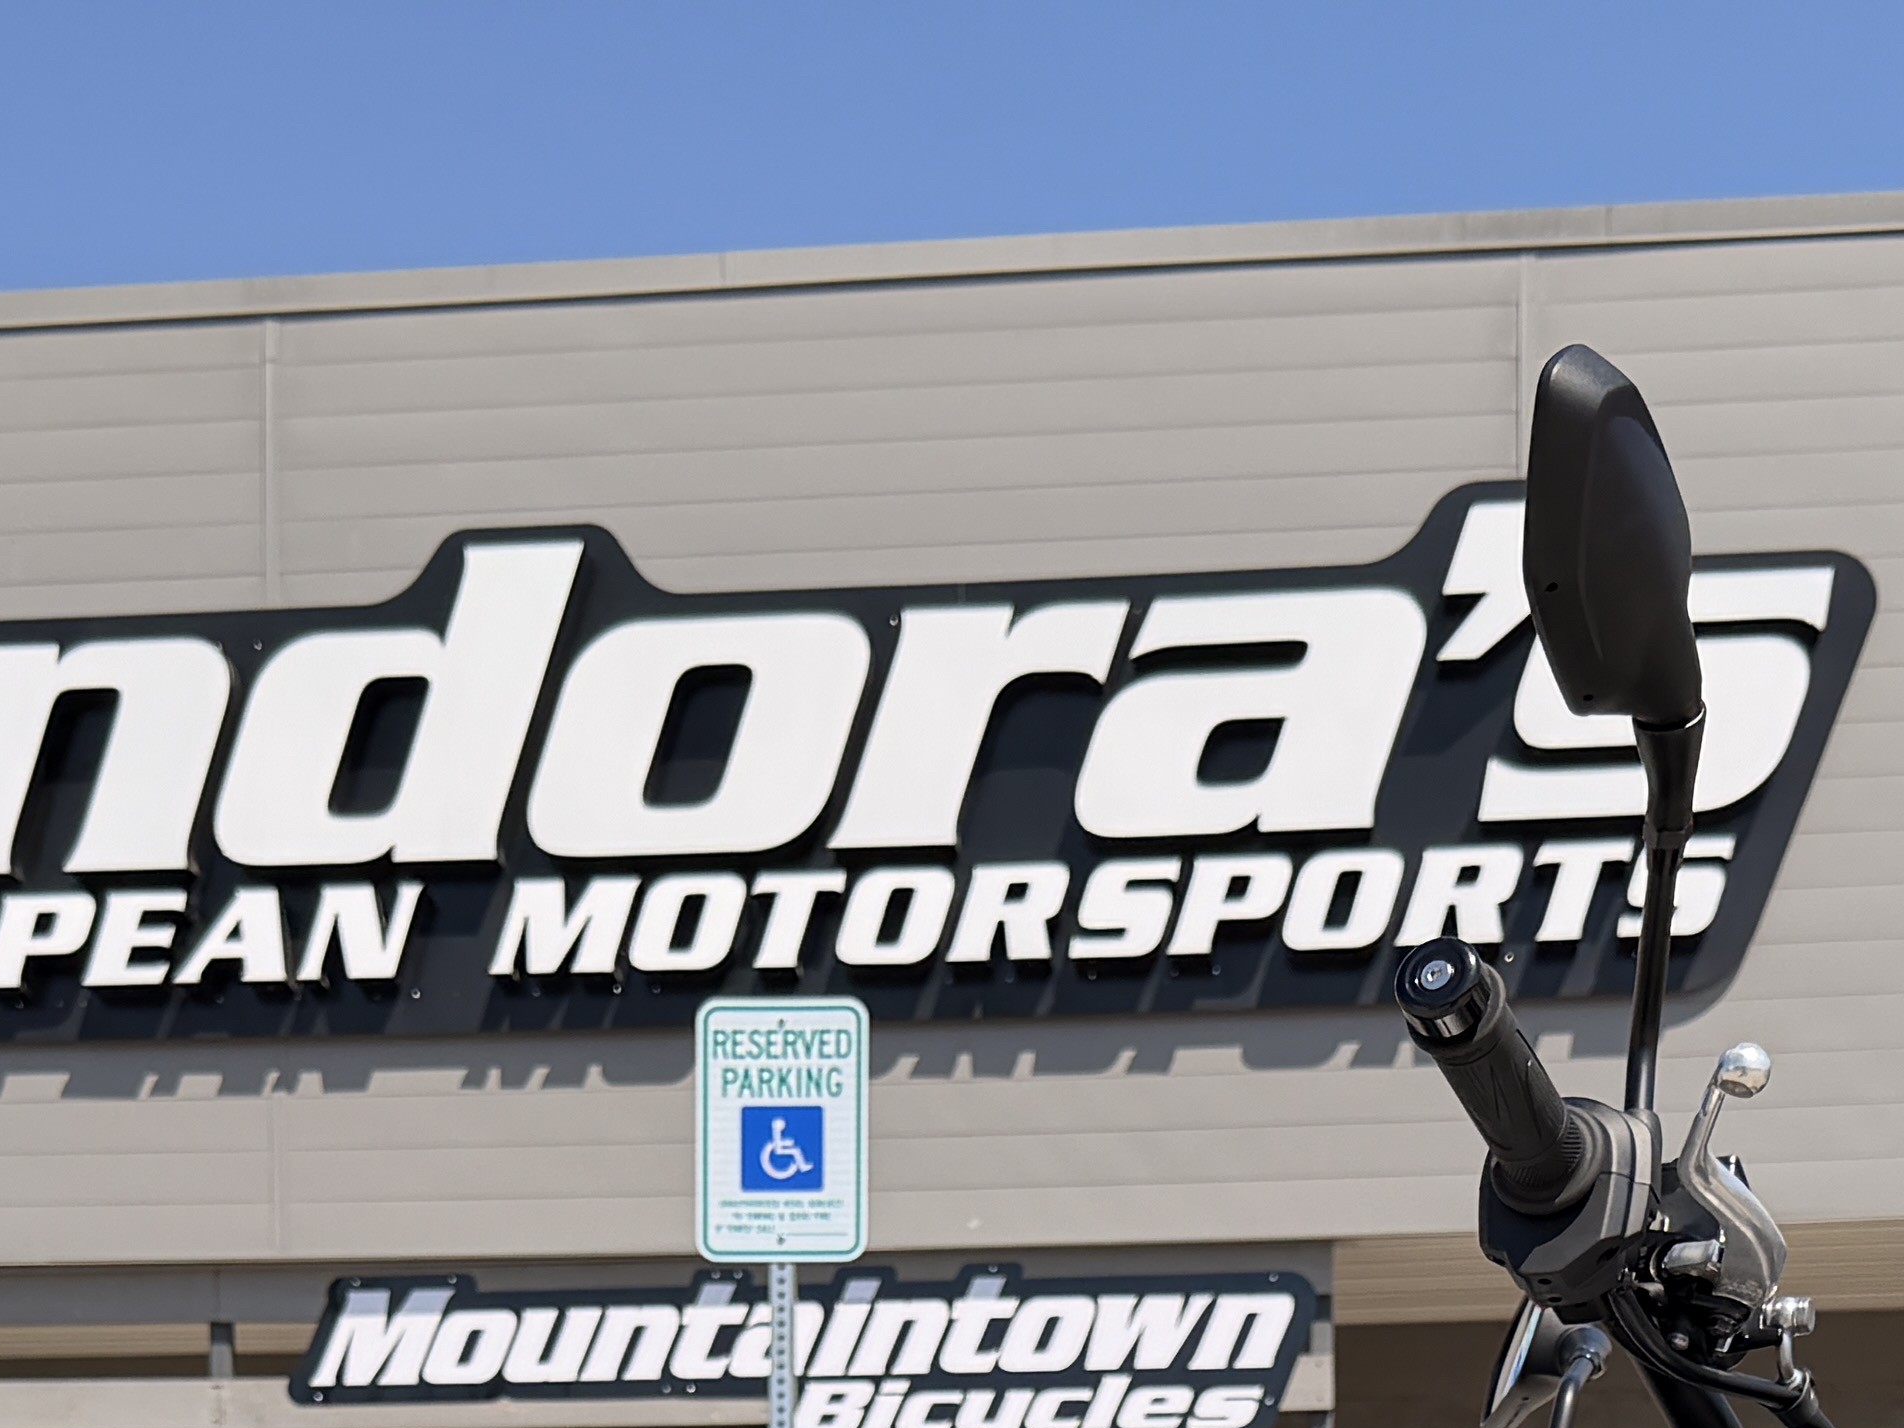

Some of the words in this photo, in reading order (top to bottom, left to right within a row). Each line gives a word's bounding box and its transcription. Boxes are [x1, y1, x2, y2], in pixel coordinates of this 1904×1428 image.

[490, 836, 1734, 976] MOTORSPORTS
[712, 1029, 852, 1060] RESERVED
[721, 1066, 844, 1098] PARKING
[310, 1275, 1295, 1388] Mountaintown
